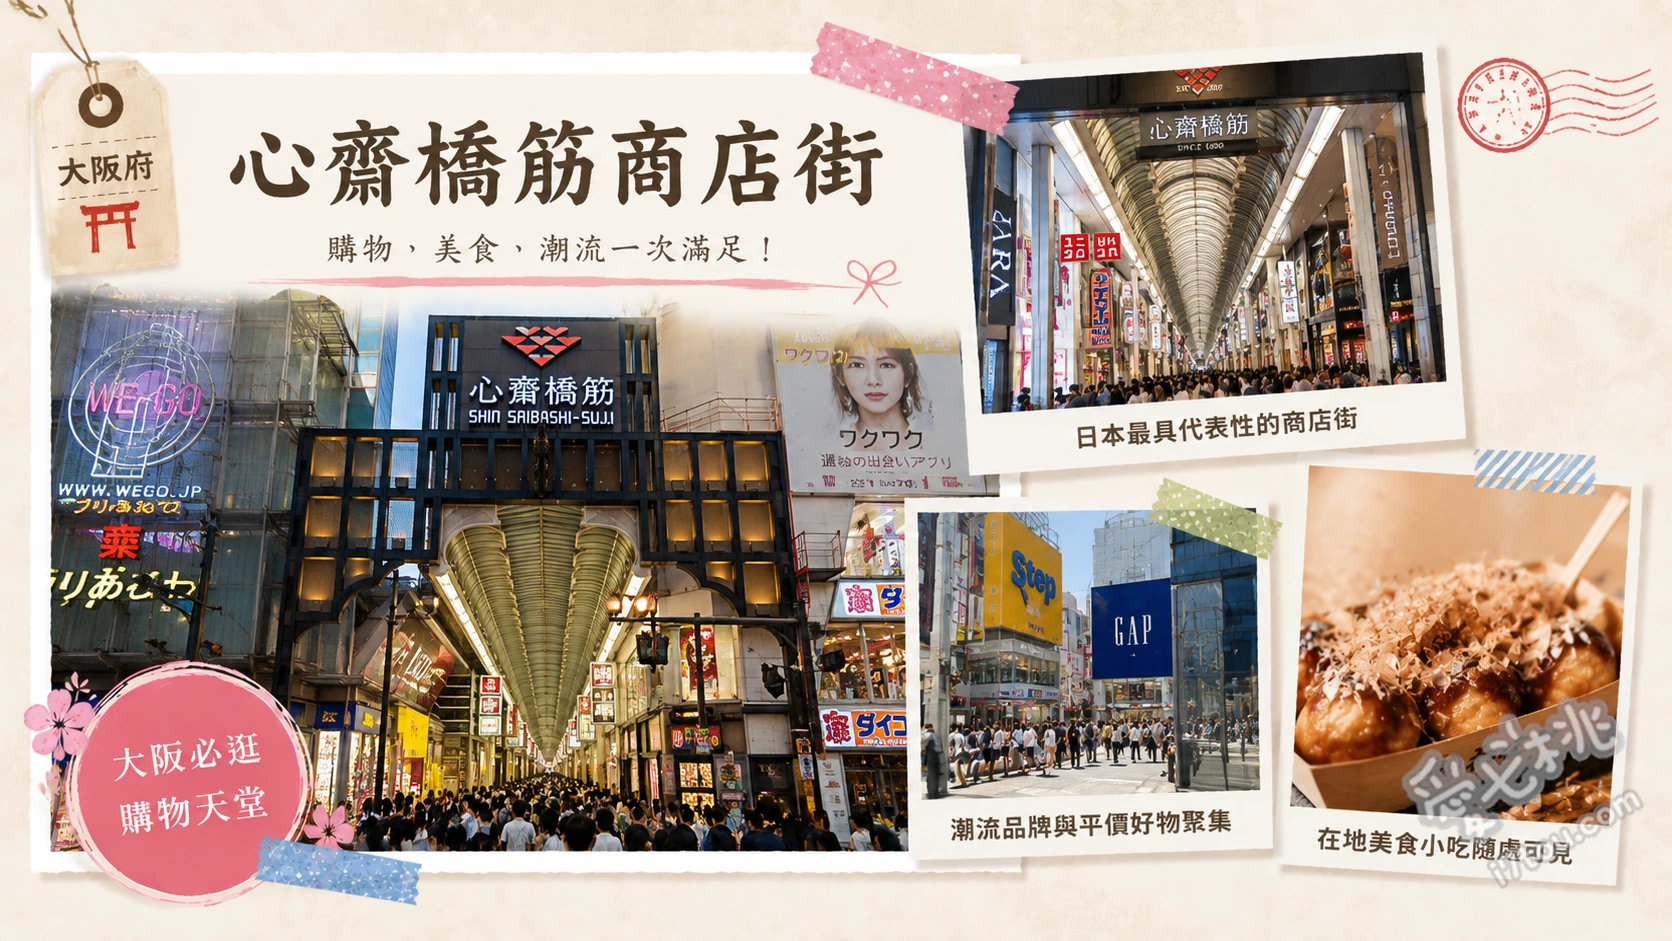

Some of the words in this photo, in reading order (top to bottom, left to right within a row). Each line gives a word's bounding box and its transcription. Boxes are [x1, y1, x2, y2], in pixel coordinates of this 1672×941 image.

[469, 409, 500, 424] SHIN
[840, 429, 923, 450] ワクワク
[1011, 550, 1056, 606] Step
[1114, 614, 1152, 646] GAP
